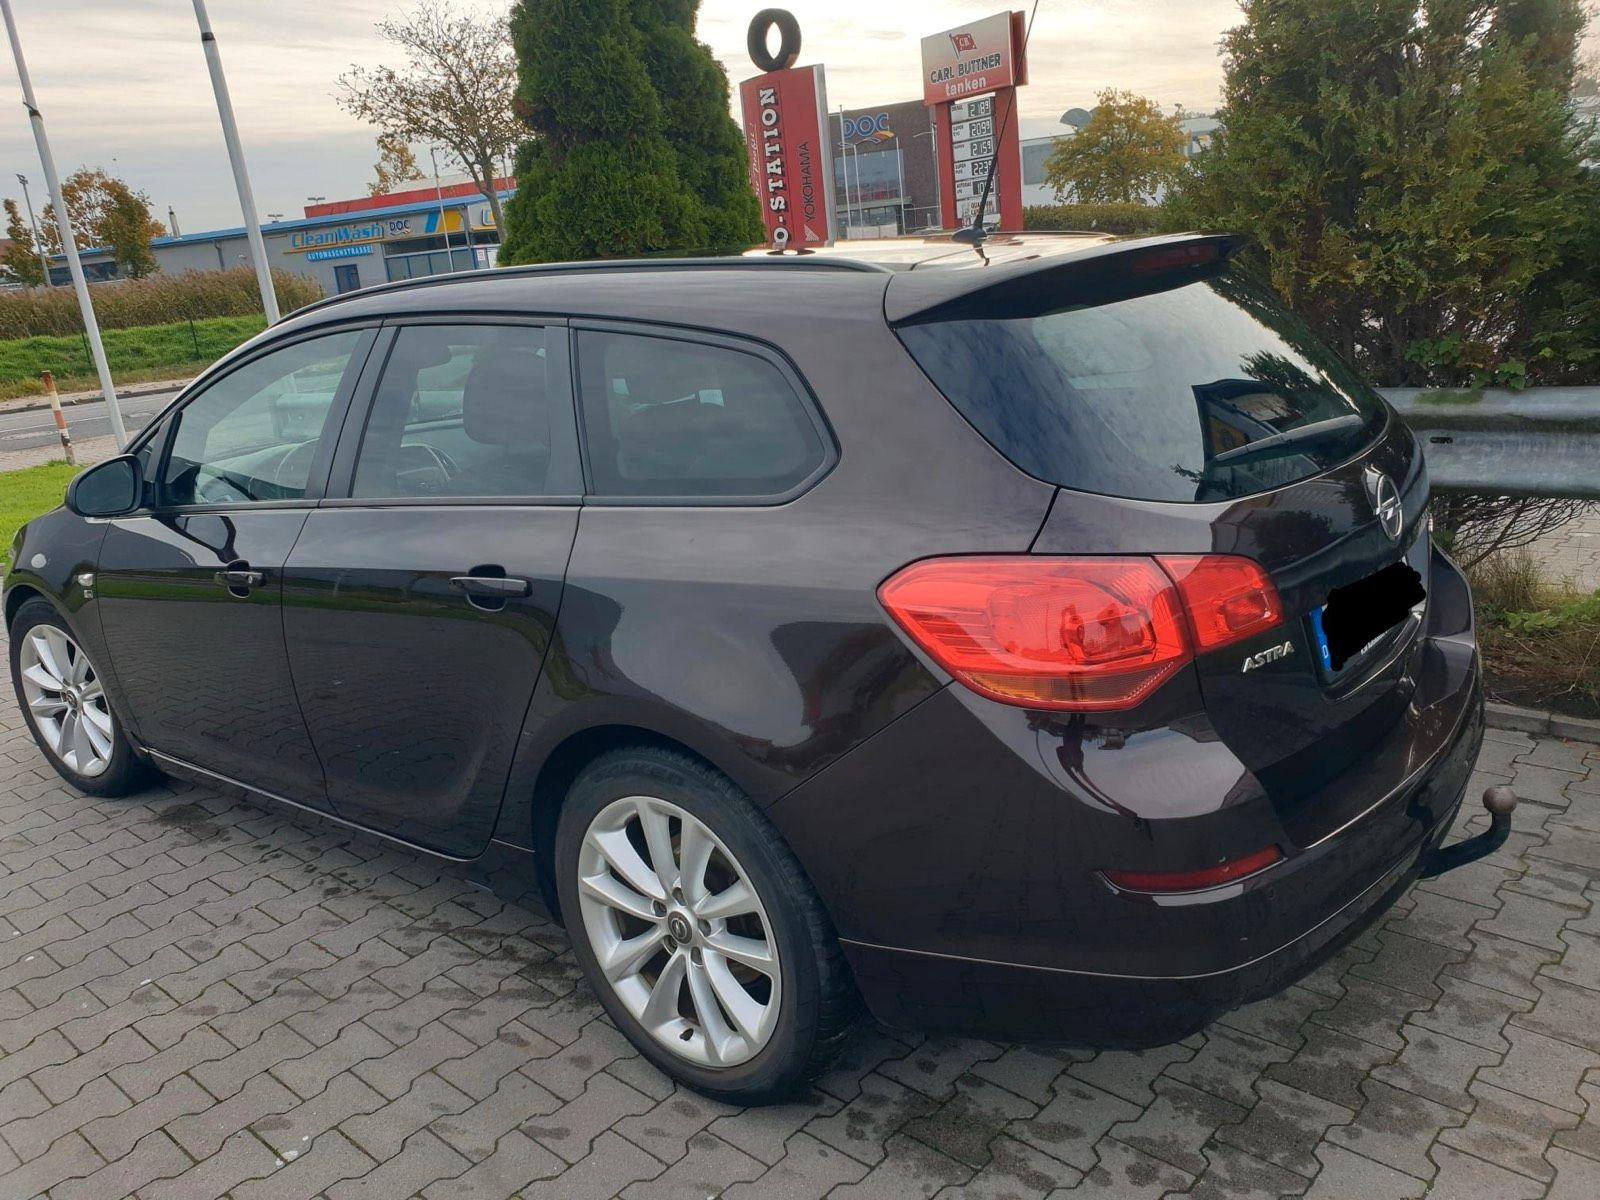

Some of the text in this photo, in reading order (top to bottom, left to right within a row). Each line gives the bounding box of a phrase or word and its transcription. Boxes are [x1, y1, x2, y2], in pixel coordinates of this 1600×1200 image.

[930, 66, 954, 83] CARL
[945, 76, 986, 97] tanken
[842, 112, 890, 139] DOC
[799, 141, 816, 223] YOKOHAMA
[291, 223, 383, 249] CleanWash
[389, 219, 411, 232] DOC
[1242, 640, 1295, 673] ASTRA
[1321, 644, 1329, 659] D
